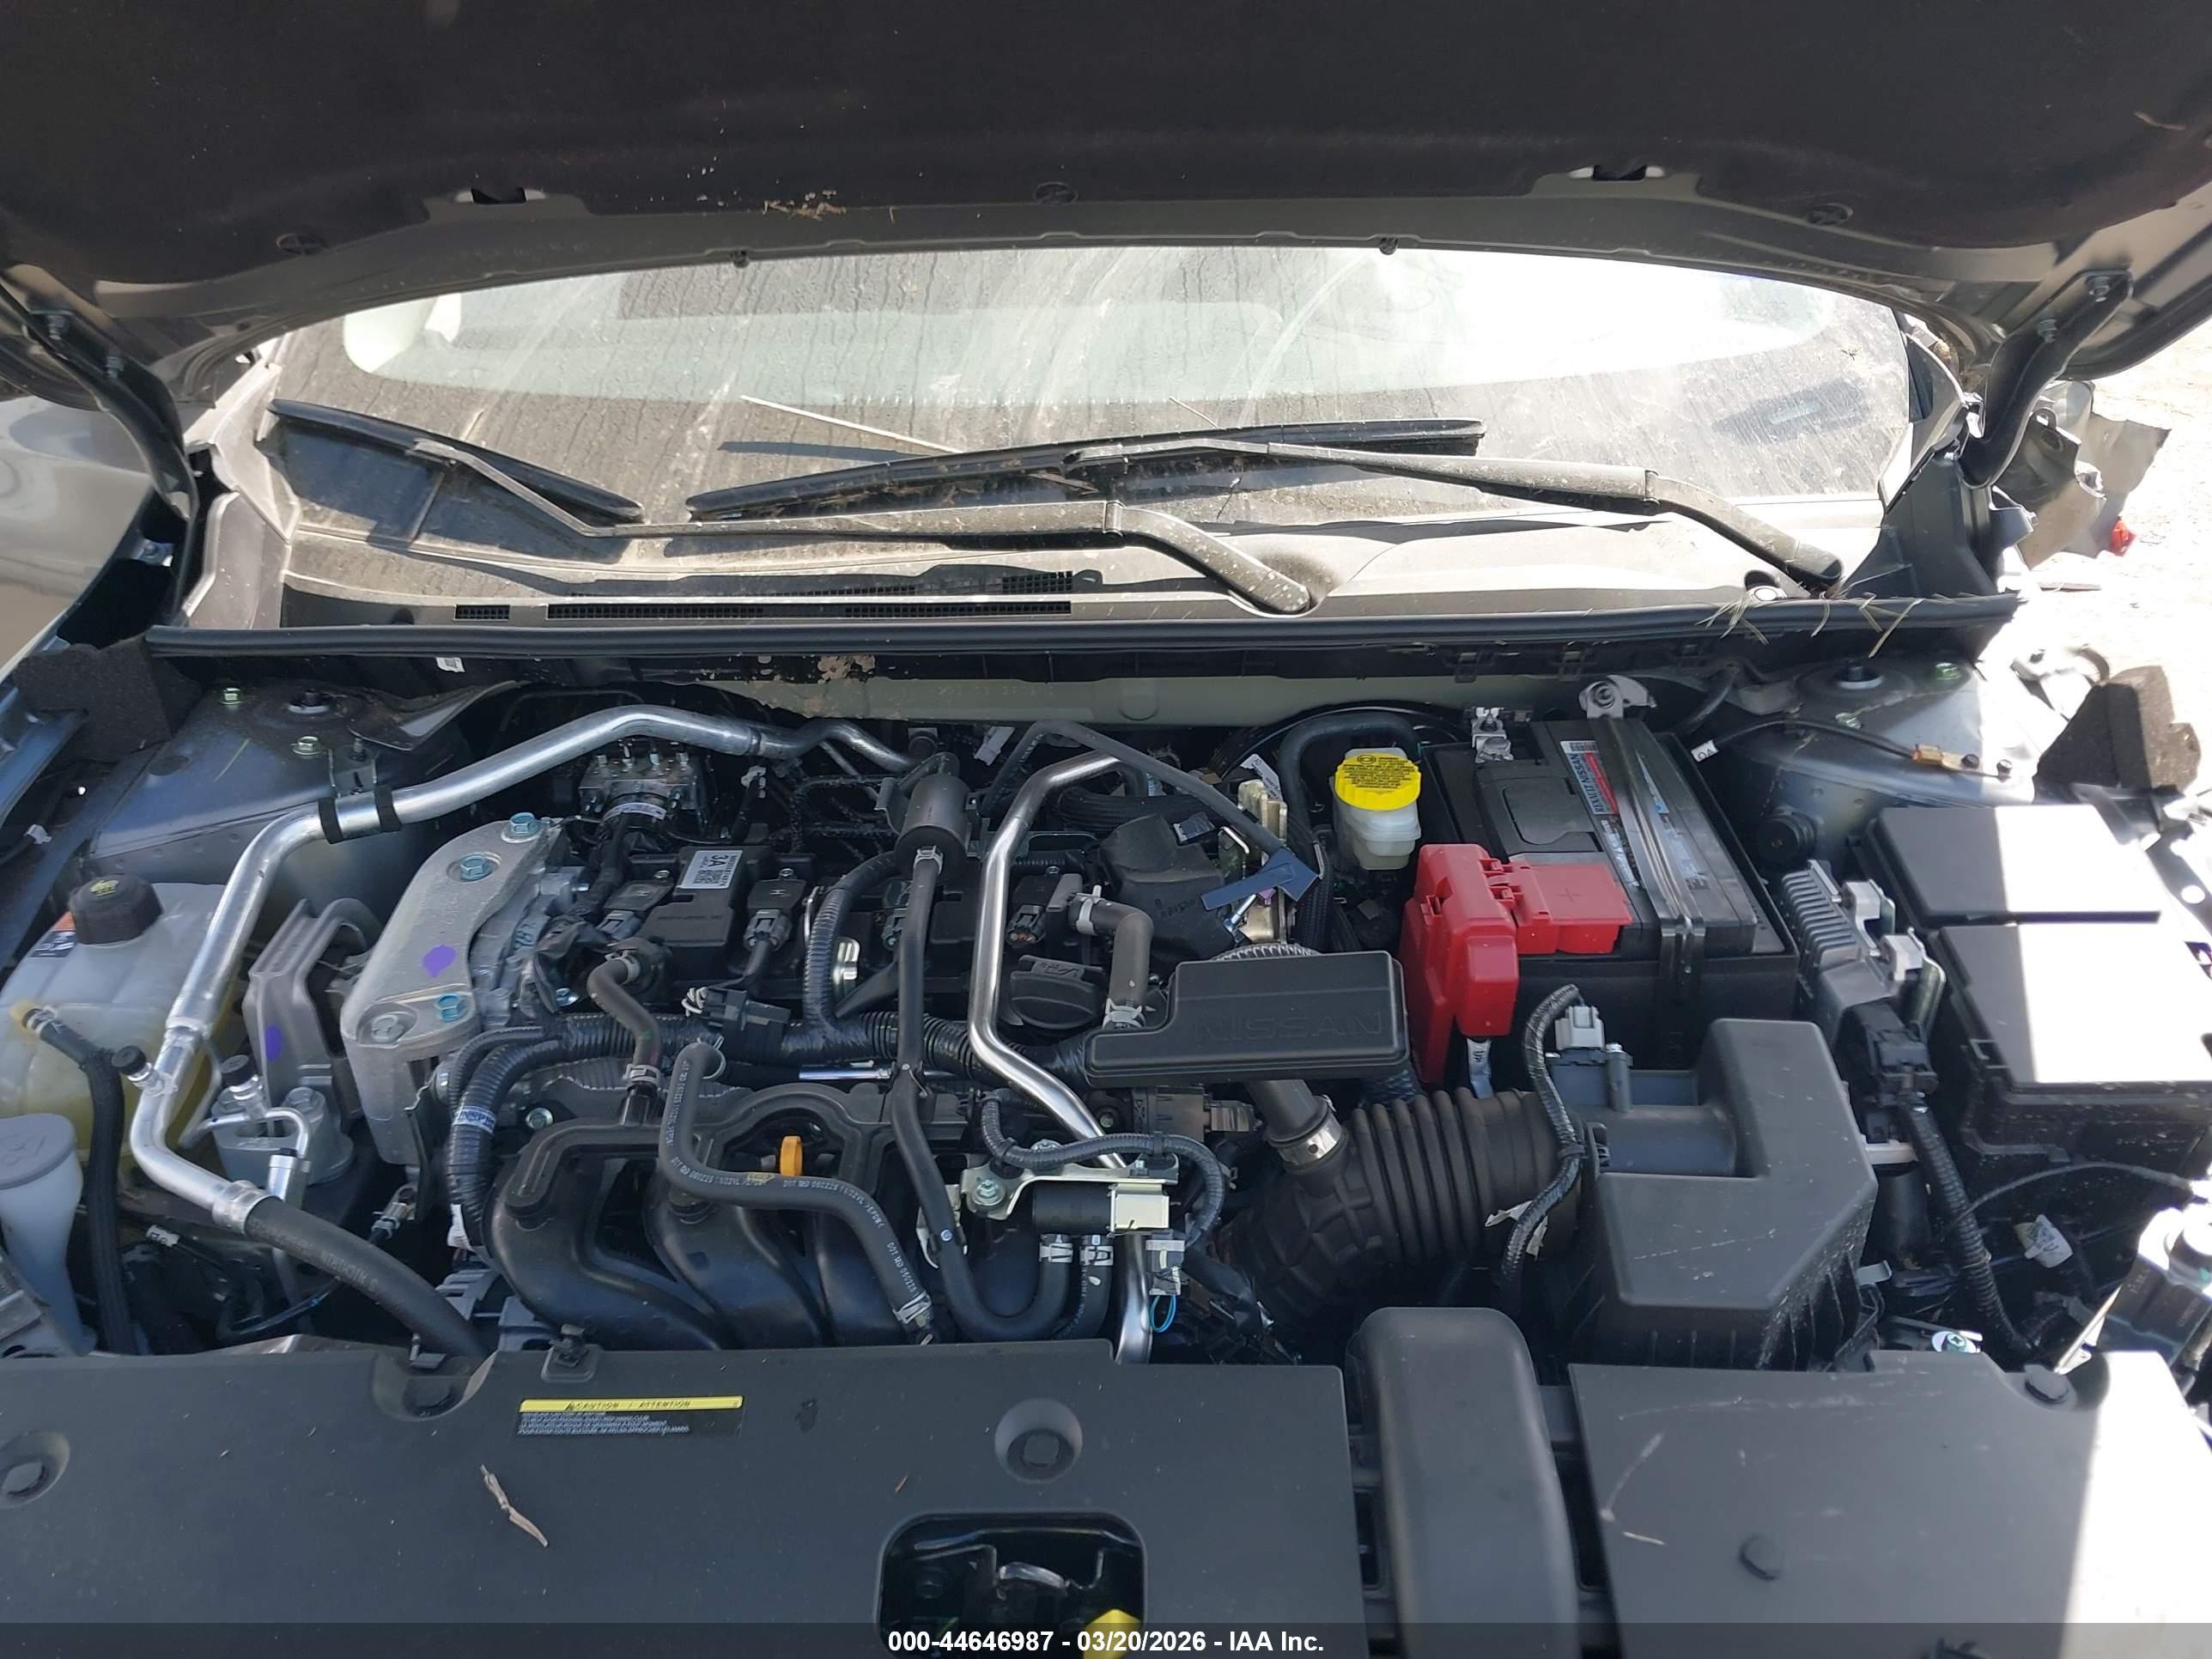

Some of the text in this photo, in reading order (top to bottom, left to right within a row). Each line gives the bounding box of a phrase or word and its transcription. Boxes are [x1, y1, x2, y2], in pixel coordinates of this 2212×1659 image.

[1569, 753, 1605, 813] RENAULT NISSAN
[707, 854, 729, 867] 3A
[1194, 1012, 1382, 1042] NISSAN
[575, 1401, 620, 1410] CAUTION
[639, 1401, 692, 1409] ATTENTION
